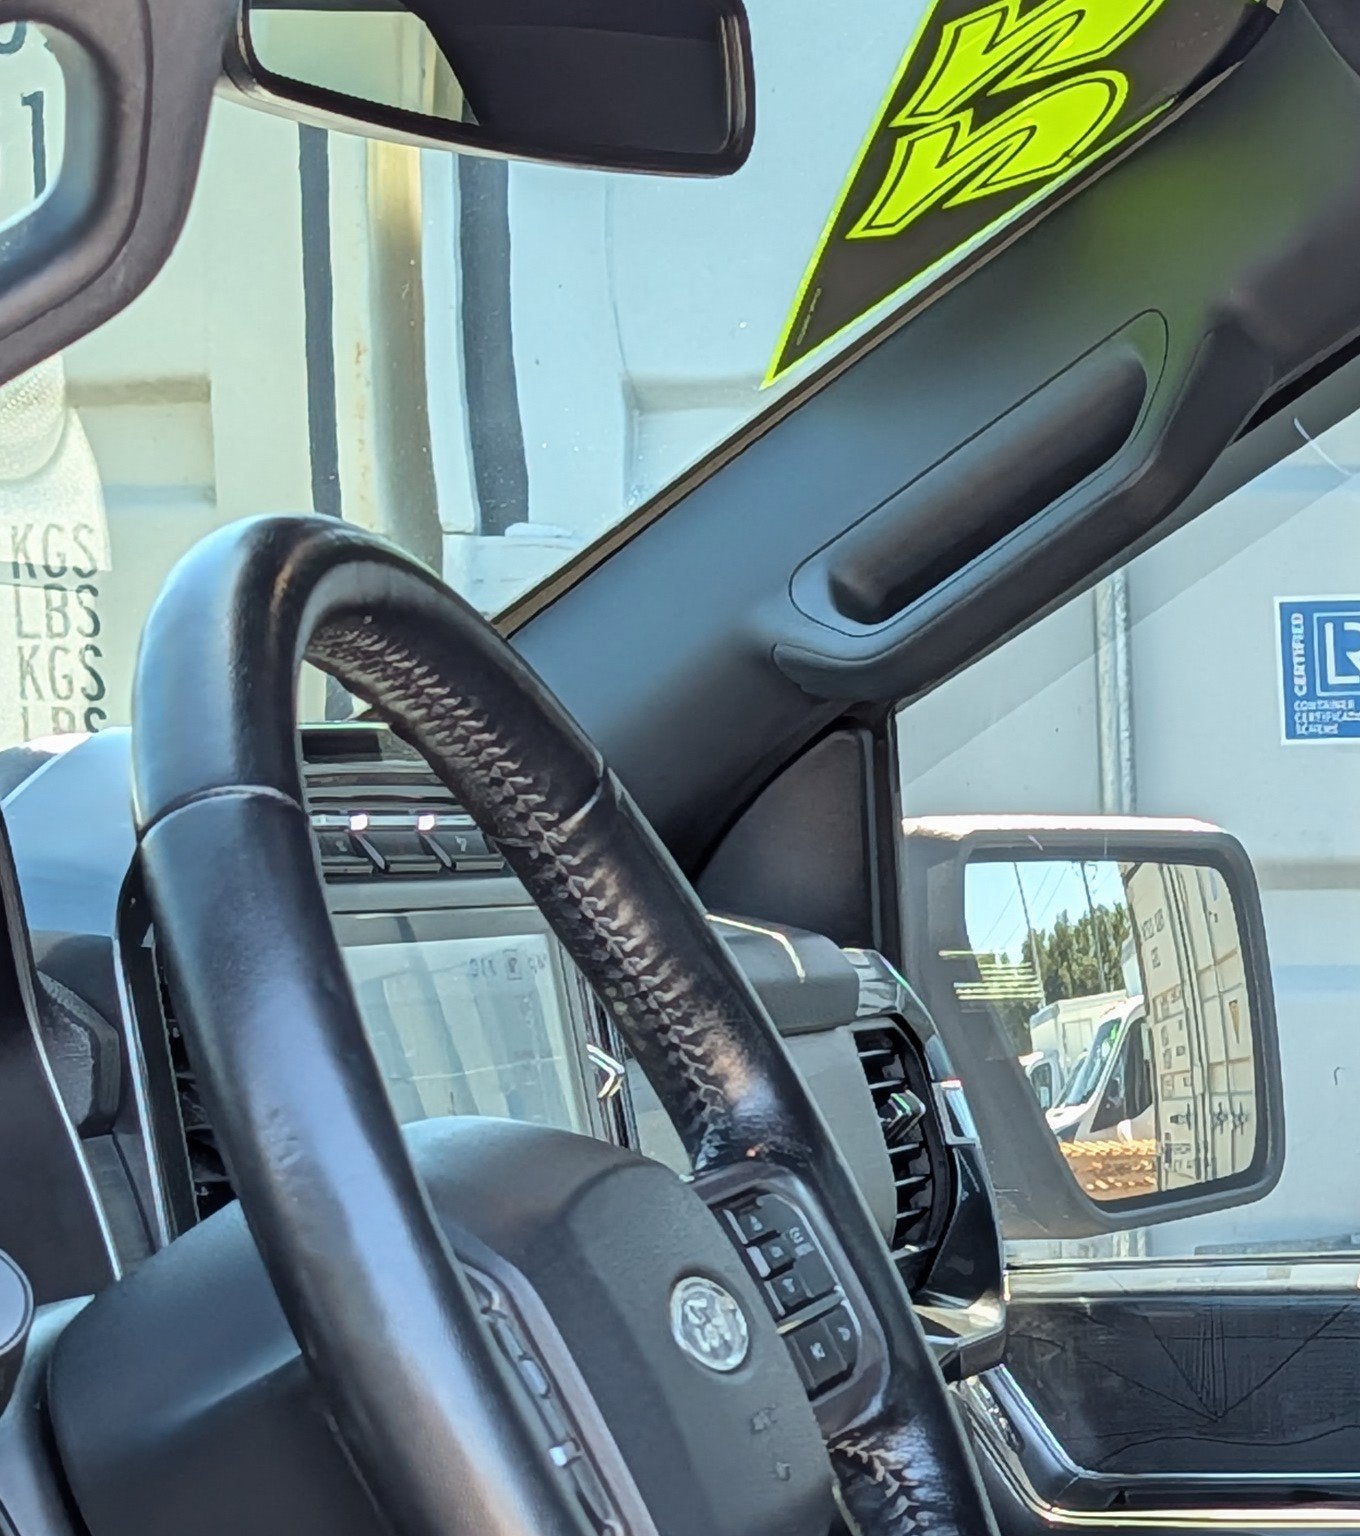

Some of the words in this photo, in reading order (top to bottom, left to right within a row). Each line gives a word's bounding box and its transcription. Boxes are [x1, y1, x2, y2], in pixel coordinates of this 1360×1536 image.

[11, 523, 98, 579] KGS
[15, 583, 101, 639] LBS
[18, 644, 106, 701] KGS
